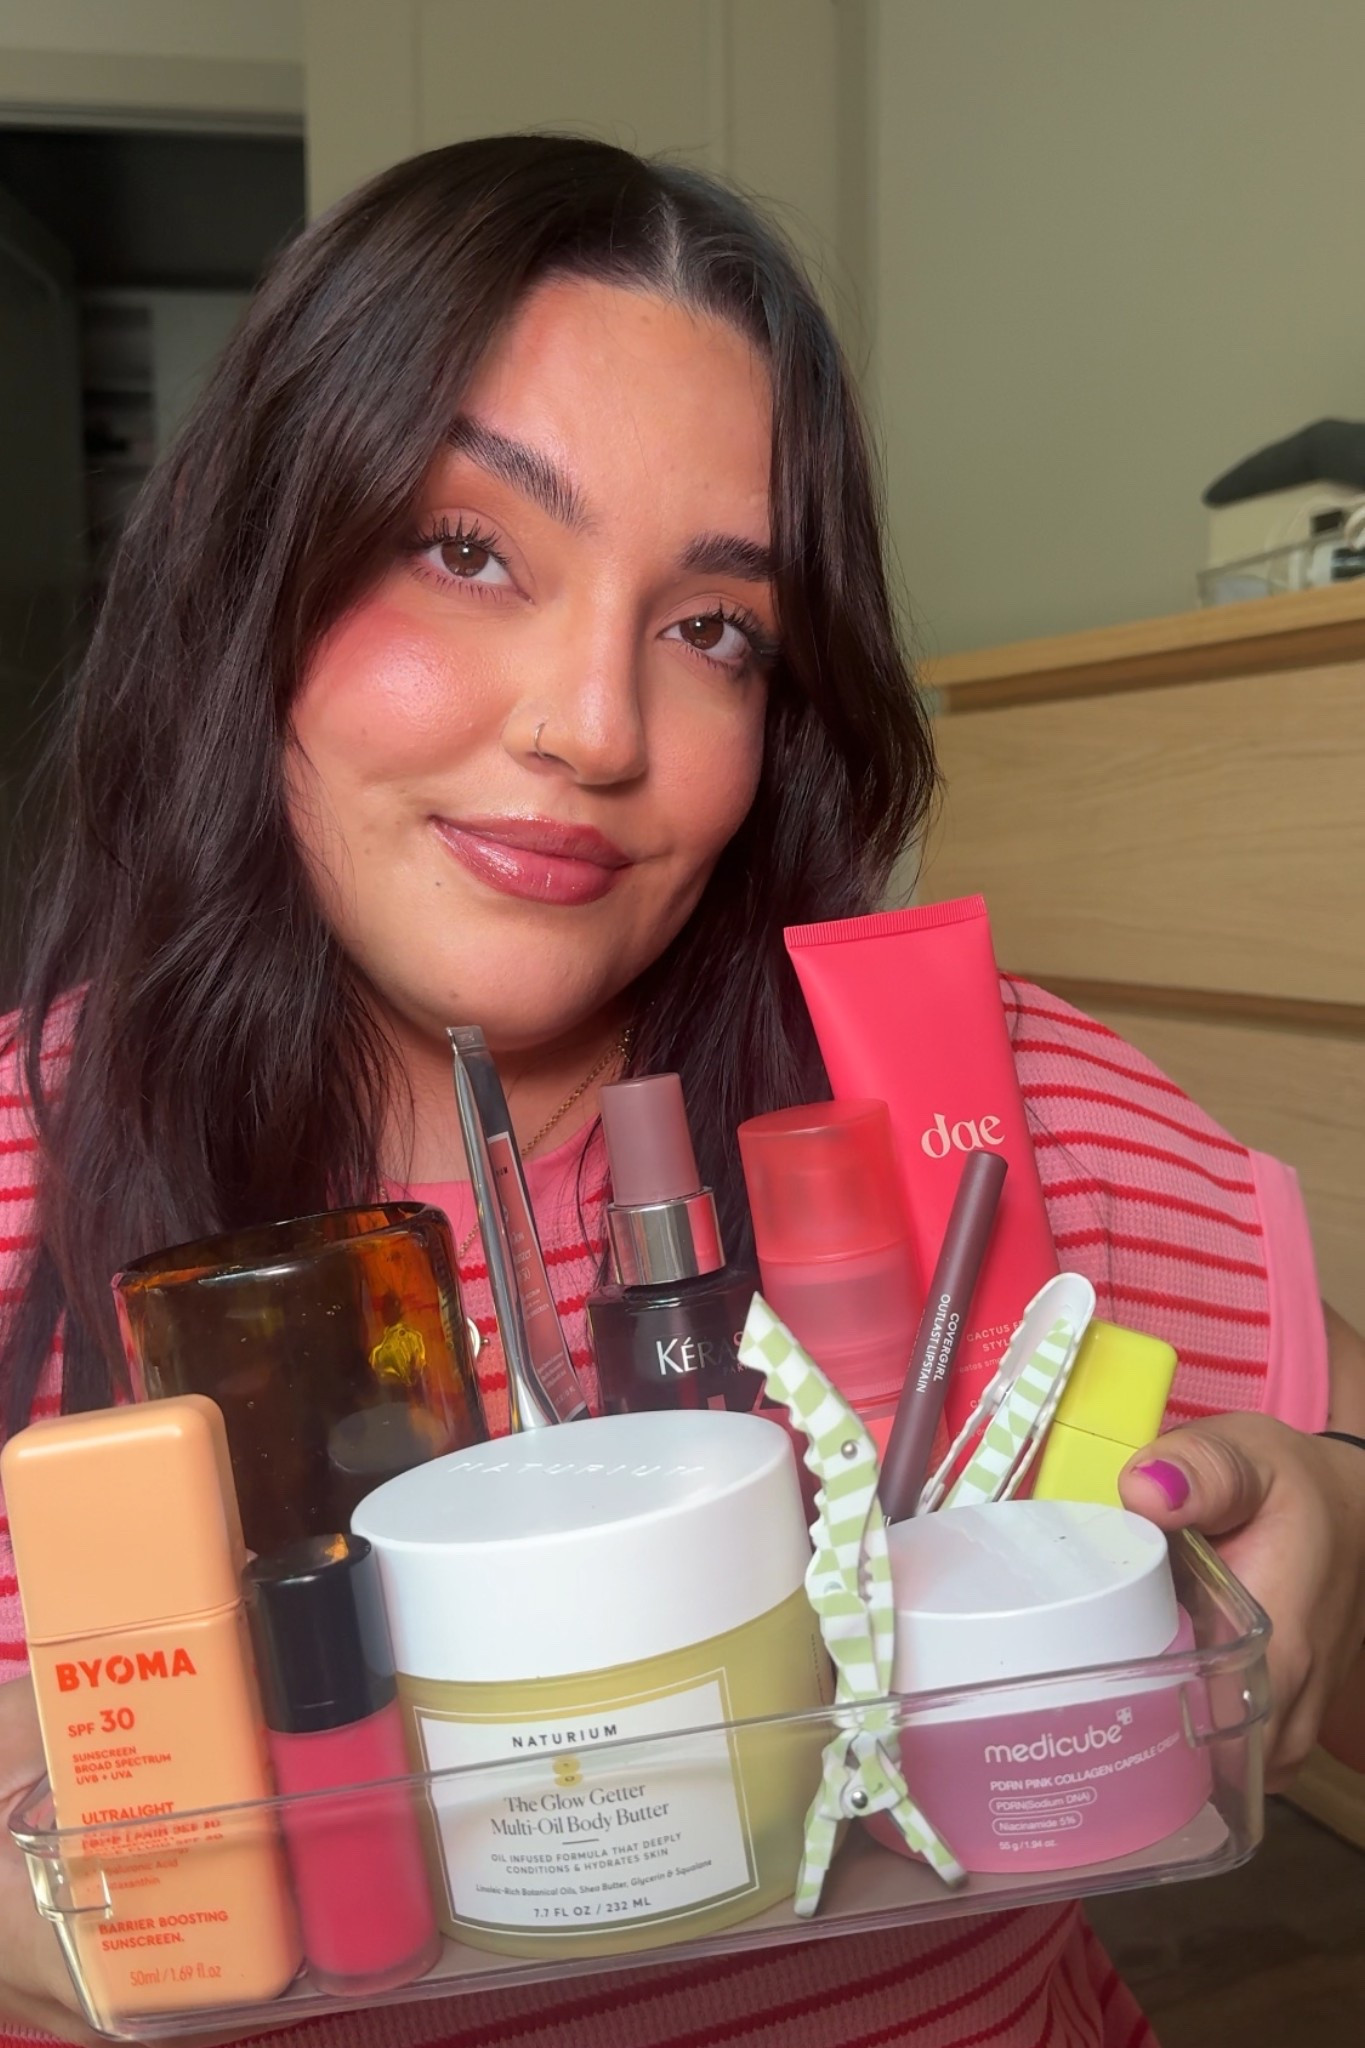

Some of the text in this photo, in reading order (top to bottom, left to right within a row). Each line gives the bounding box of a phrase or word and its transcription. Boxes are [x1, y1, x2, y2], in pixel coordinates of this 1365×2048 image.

[920, 1112, 1006, 1160] dae
[928, 1293, 951, 1345] OUTLAST
[966, 1323, 1011, 1342] CACTUS
[933, 1312, 960, 1382] COVERGIRL
[982, 1338, 1010, 1353] STYL
[915, 1345, 938, 1394] LIPSTAIN
[55, 1648, 197, 1693] BYOMA
[67, 1707, 135, 1738] SPF 30
[511, 1723, 618, 1748] NATURIUM
[72, 1746, 137, 1763] SUNSCREEN
[984, 1724, 1122, 1763] medicube
[74, 1753, 172, 1774] BROAD SPECTRUM
[76, 1773, 99, 1785] UVB
[110, 1769, 134, 1781] UVA
[990, 1780, 1023, 1791] PDRN
[1025, 1777, 1054, 1789] PINK
[1054, 1763, 1114, 1786] COLLAGEN
[1114, 1746, 1157, 1772] CAPSULE
[503, 1784, 646, 1813] The Glow Getter
[81, 1801, 175, 1826] ULTRALIGHT
[490, 1802, 670, 1836] Multi-Oil Body Butter
[999, 1815, 1077, 1831] Niacinamide 5%
[491, 1832, 682, 1863] OIL INFUSED FORMULA THAT DEEPLY
[506, 1848, 669, 1875] CONDITIONS & HYDRATES SKIN
[522, 1887, 558, 1896] Botanical
[579, 1884, 601, 1894] Shea
[601, 1881, 629, 1891] Butter,
[630, 1872, 666, 1887] Glycerin
[675, 1859, 712, 1876] Squalane
[533, 1907, 550, 1918] 7.7
[554, 1908, 569, 1917] FL
[573, 1905, 592, 1916] OZ
[605, 1900, 629, 1913] 232
[632, 1896, 652, 1908] ML
[98, 1910, 228, 1935] BARRIER BOOSTING
[101, 1932, 185, 1951] SUNSCREEN.
[170, 1964, 194, 1982] 1.69
